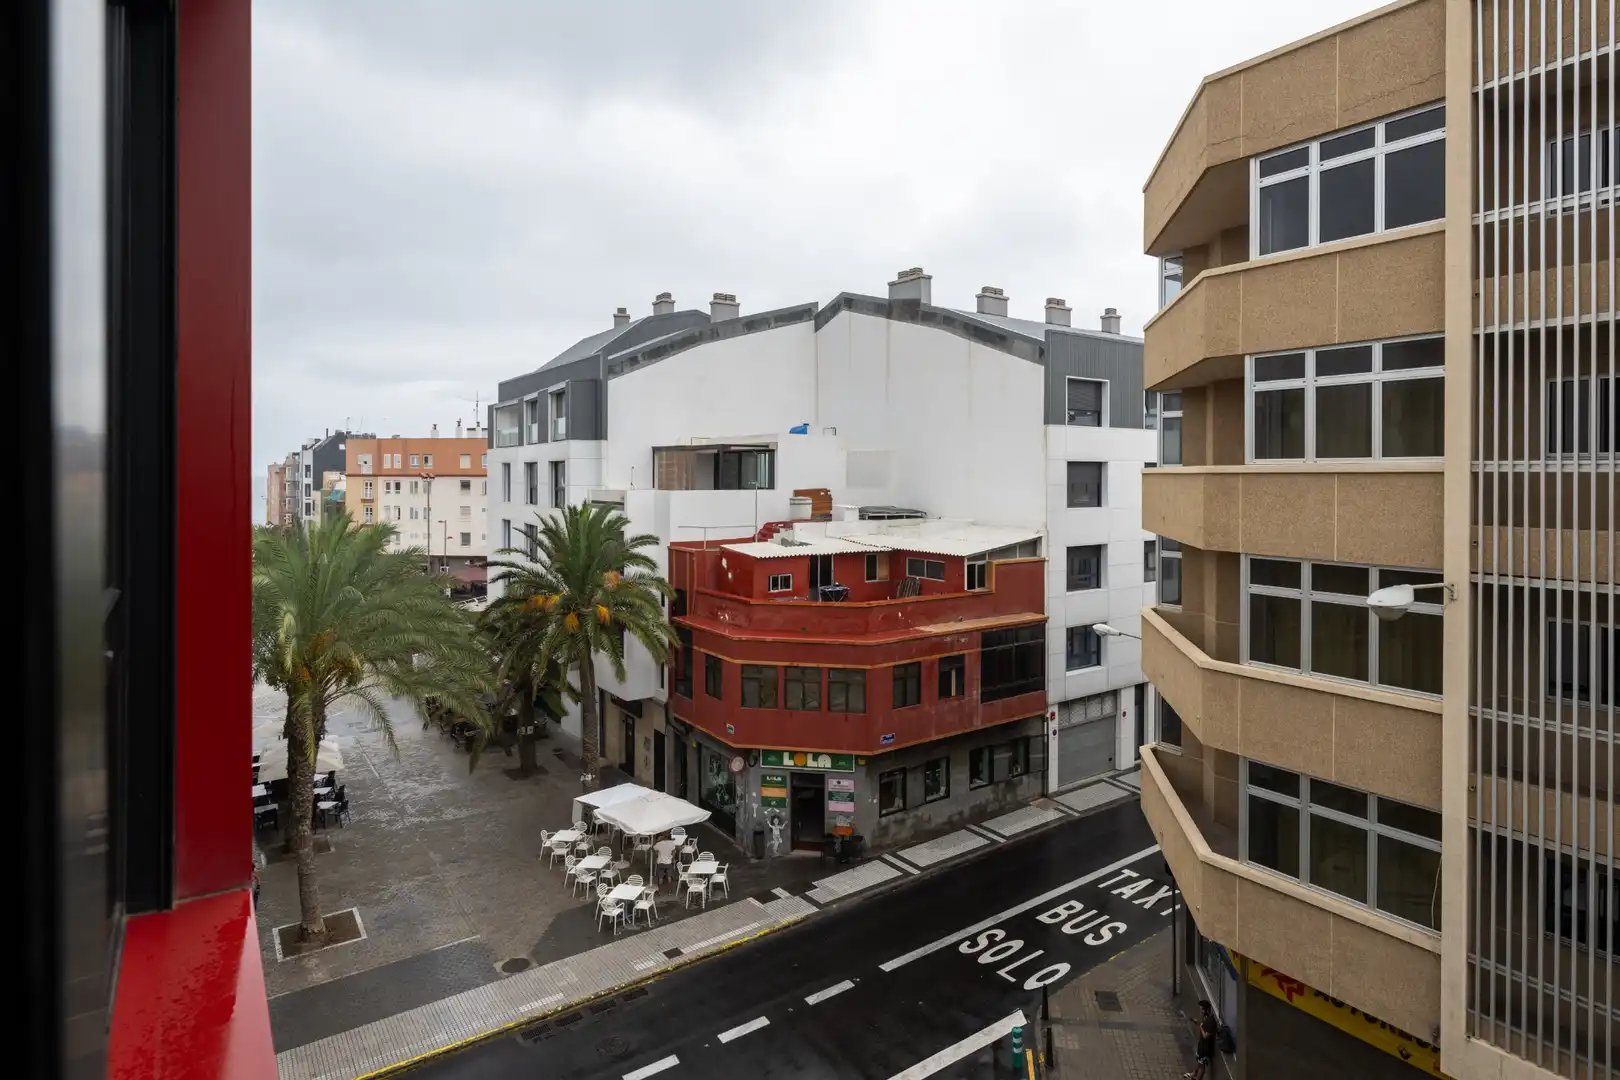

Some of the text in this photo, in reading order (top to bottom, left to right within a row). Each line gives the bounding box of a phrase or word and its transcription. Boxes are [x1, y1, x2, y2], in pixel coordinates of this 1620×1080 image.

[783, 751, 831, 768] LOLA
[1035, 900, 1127, 946] BUS
[958, 928, 1071, 990] SOLO
